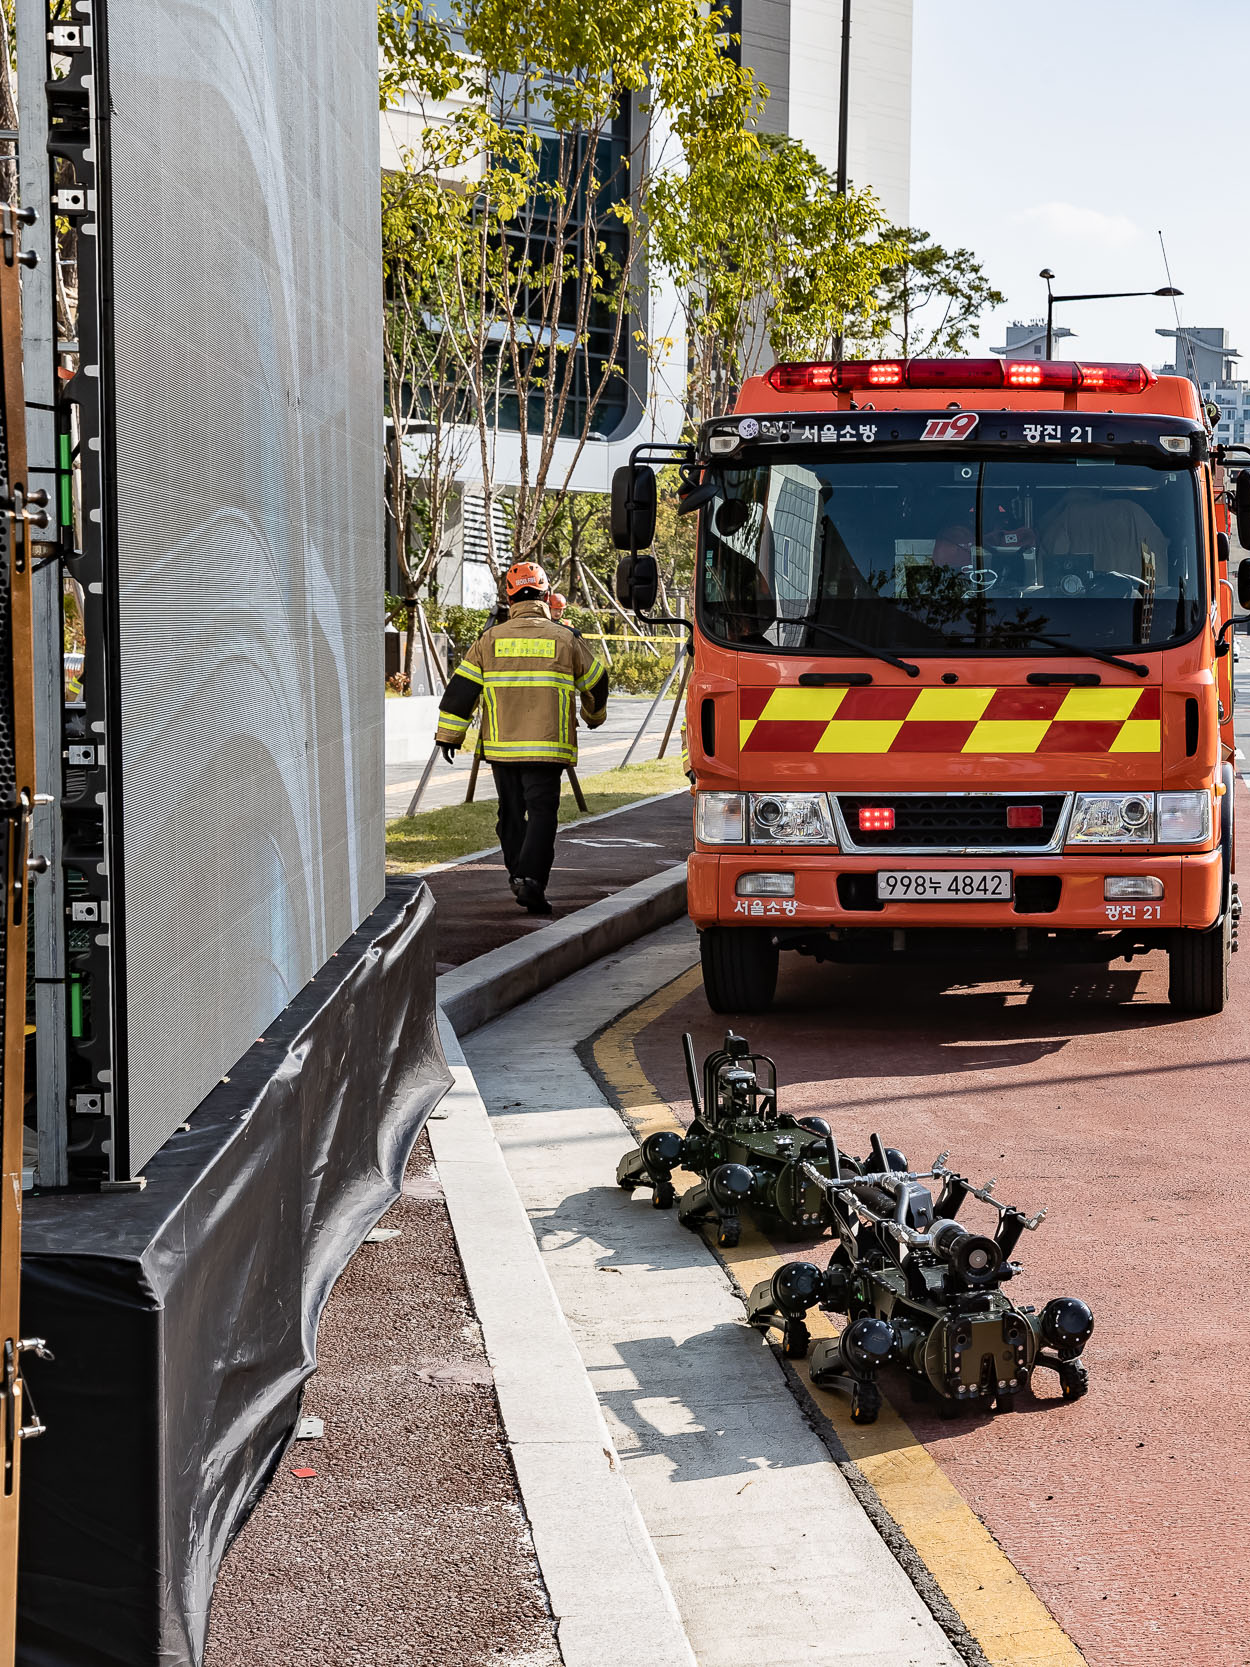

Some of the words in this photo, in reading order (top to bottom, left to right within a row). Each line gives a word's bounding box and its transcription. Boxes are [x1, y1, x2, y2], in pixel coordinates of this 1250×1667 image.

[801, 424, 878, 443] 서울소방
[920, 413, 979, 440] 119
[1023, 424, 1061, 443] 광진
[1070, 426, 1093, 443] 21
[885, 875, 942, 896] 998누
[947, 875, 1003, 896] 4842
[734, 900, 798, 916] 서울소방
[1105, 905, 1136, 921] 광진
[1143, 906, 1161, 919] 21
